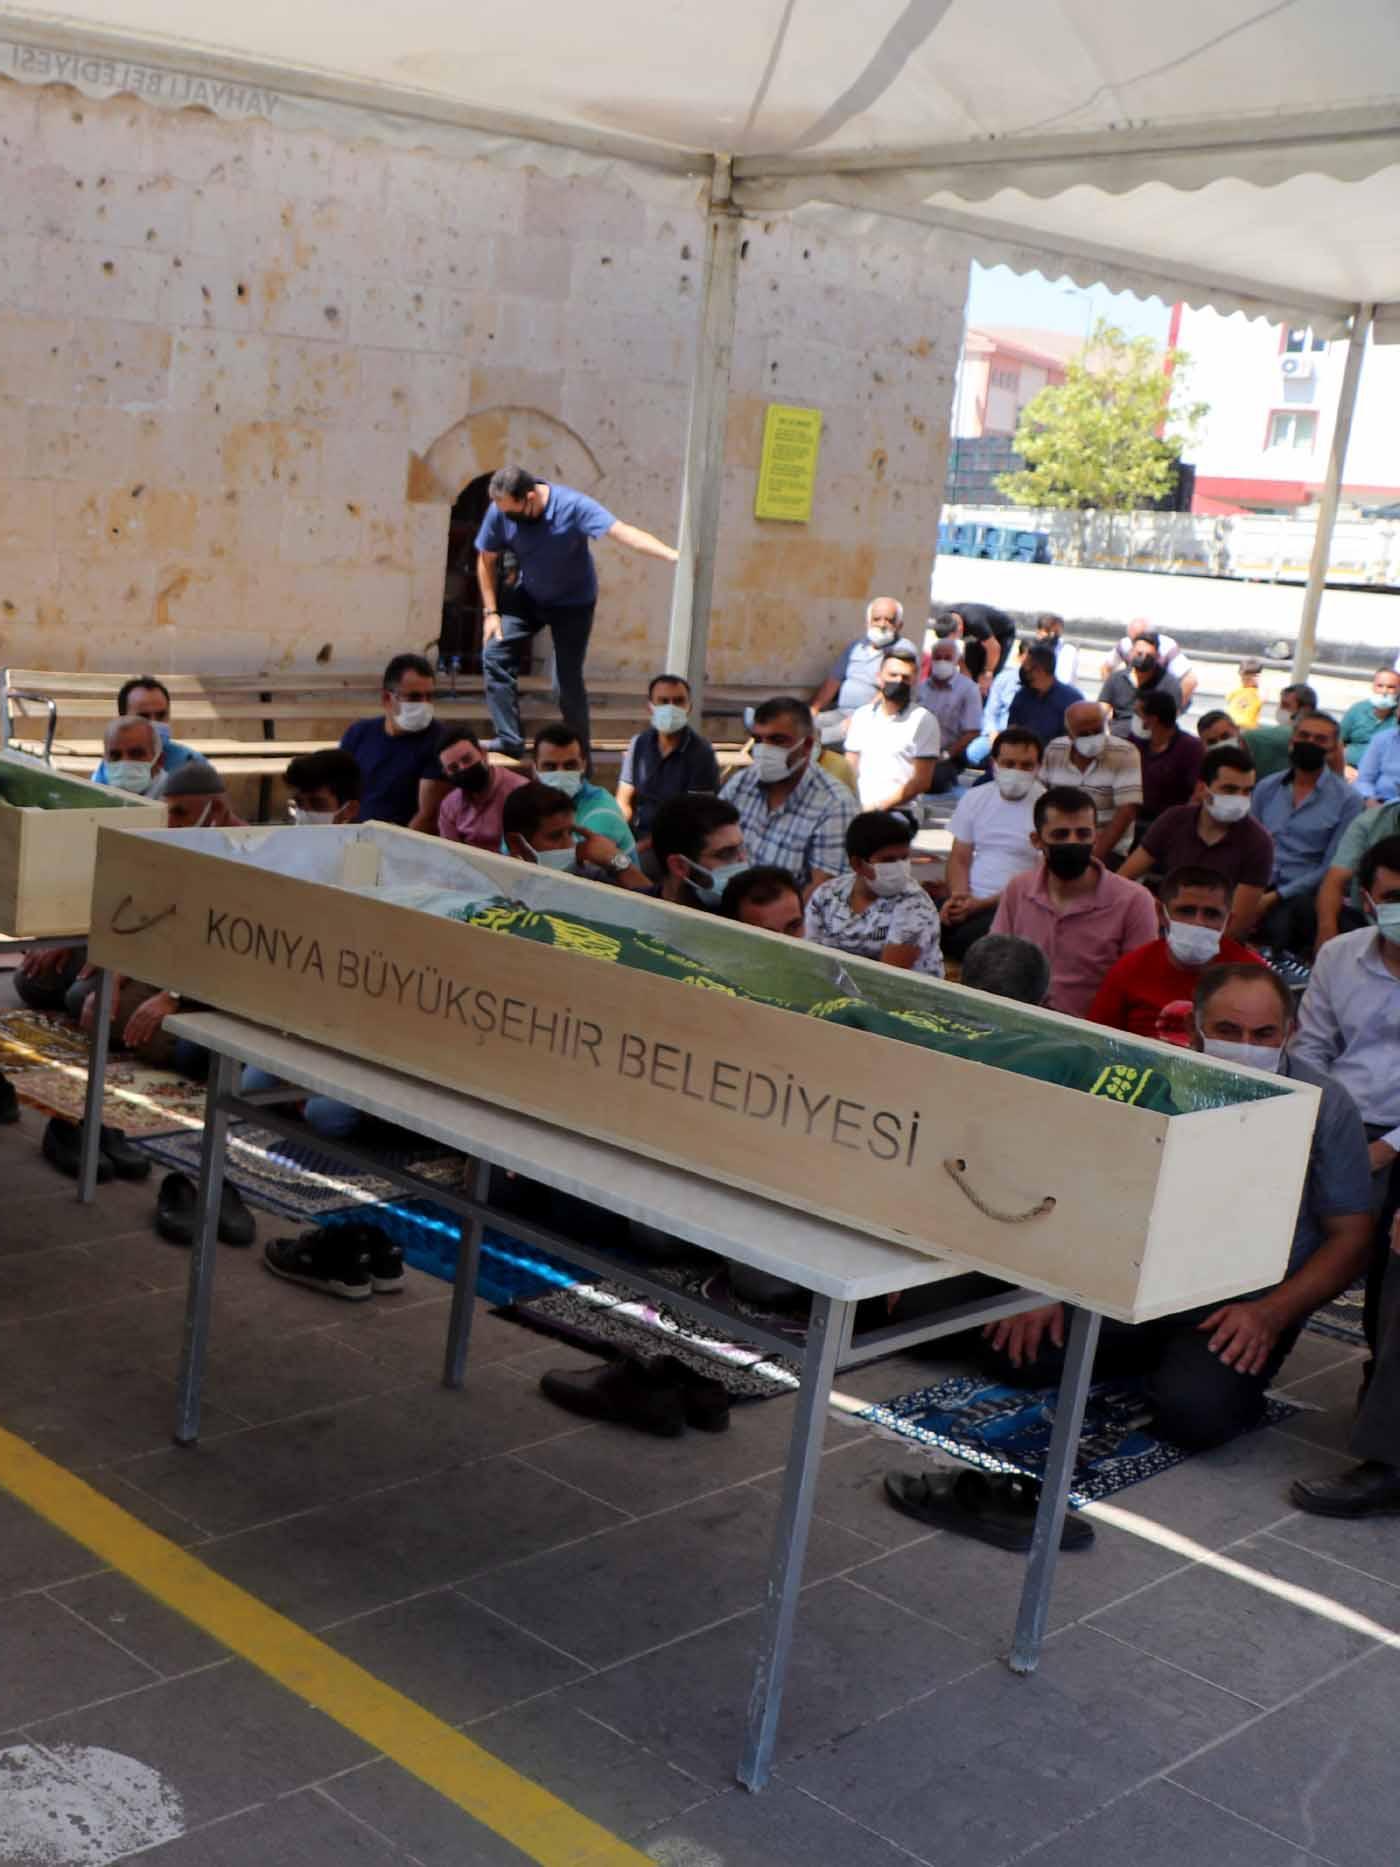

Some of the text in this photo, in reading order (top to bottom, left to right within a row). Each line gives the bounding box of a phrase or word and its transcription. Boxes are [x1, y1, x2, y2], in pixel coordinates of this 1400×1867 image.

[207, 906, 921, 1169] KONYA BÜYÜKŞEHİR BELEDİYESİ
